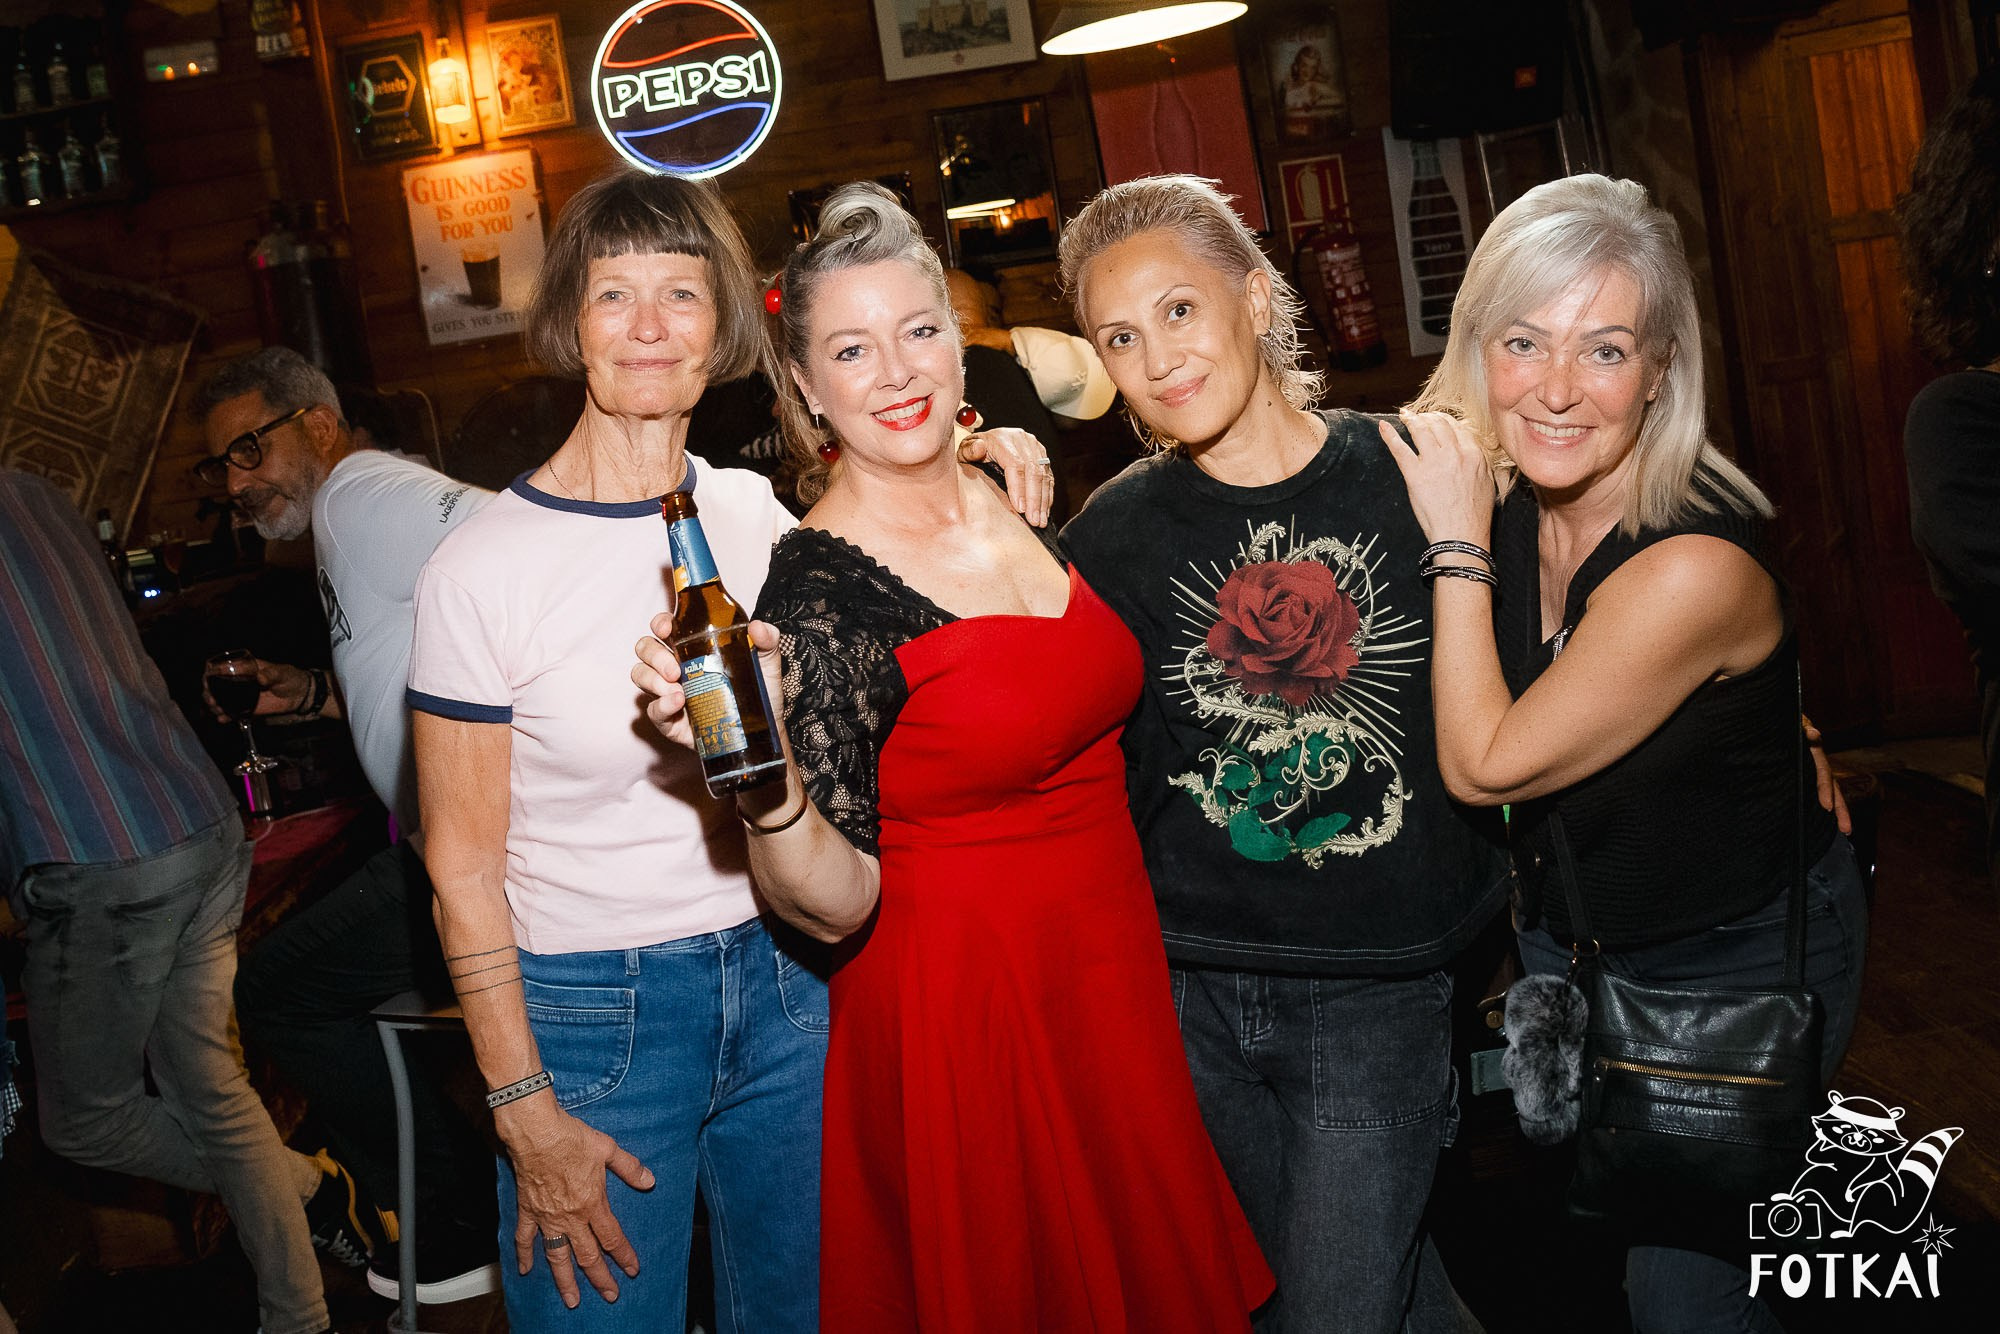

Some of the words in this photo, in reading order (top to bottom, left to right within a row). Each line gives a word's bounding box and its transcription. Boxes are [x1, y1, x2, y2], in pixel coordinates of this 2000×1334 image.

[603, 50, 772, 119] PEPSI
[411, 166, 528, 204] GUINNESS
[436, 205, 453, 222] IS
[463, 197, 511, 218] GOOD
[440, 221, 474, 242] FOR
[480, 216, 513, 236] YOU
[432, 320, 466, 334] GIVES
[471, 315, 492, 328] YOU
[438, 490, 454, 507] KARL
